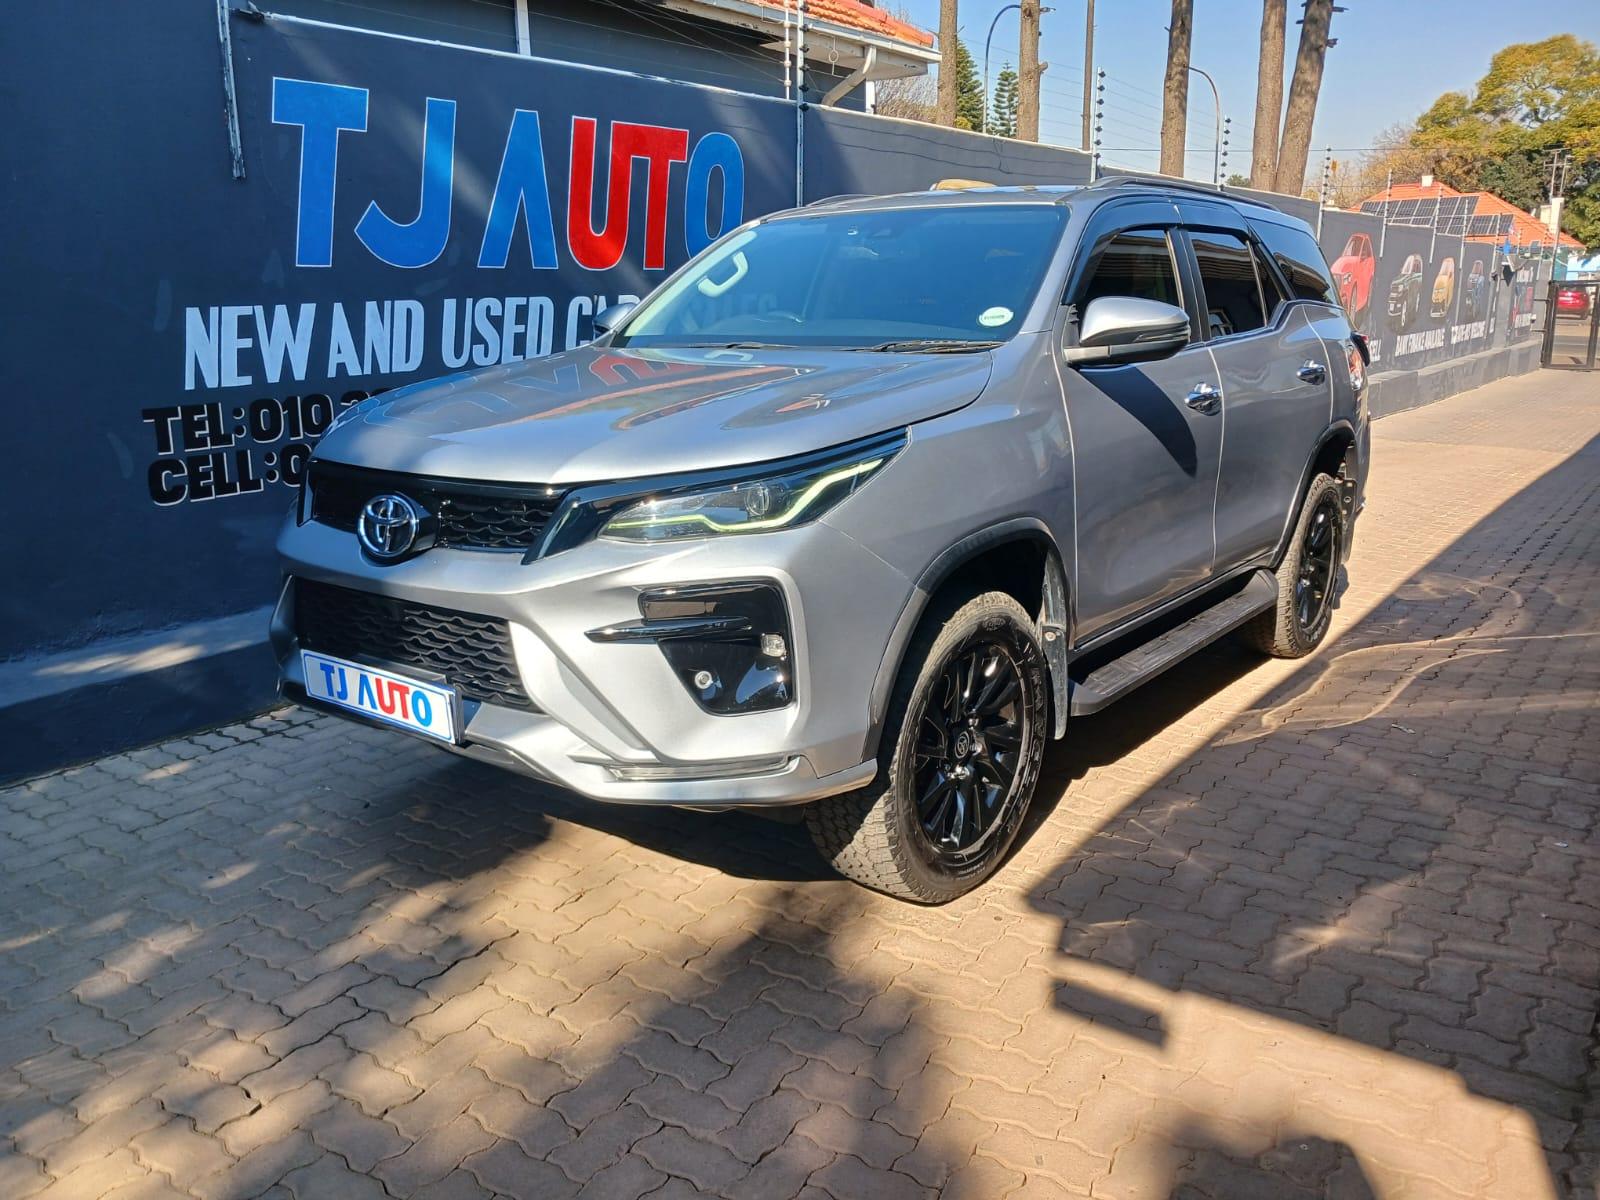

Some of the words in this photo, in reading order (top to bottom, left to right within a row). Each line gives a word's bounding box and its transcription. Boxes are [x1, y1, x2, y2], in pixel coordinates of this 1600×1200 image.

[272, 77, 457, 268] TJ
[477, 108, 745, 270] AUTO
[184, 302, 317, 391] NEW
[327, 299, 424, 378] AND
[441, 296, 554, 368] USED
[320, 663, 348, 700] TJ
[359, 674, 432, 727] AUTO
